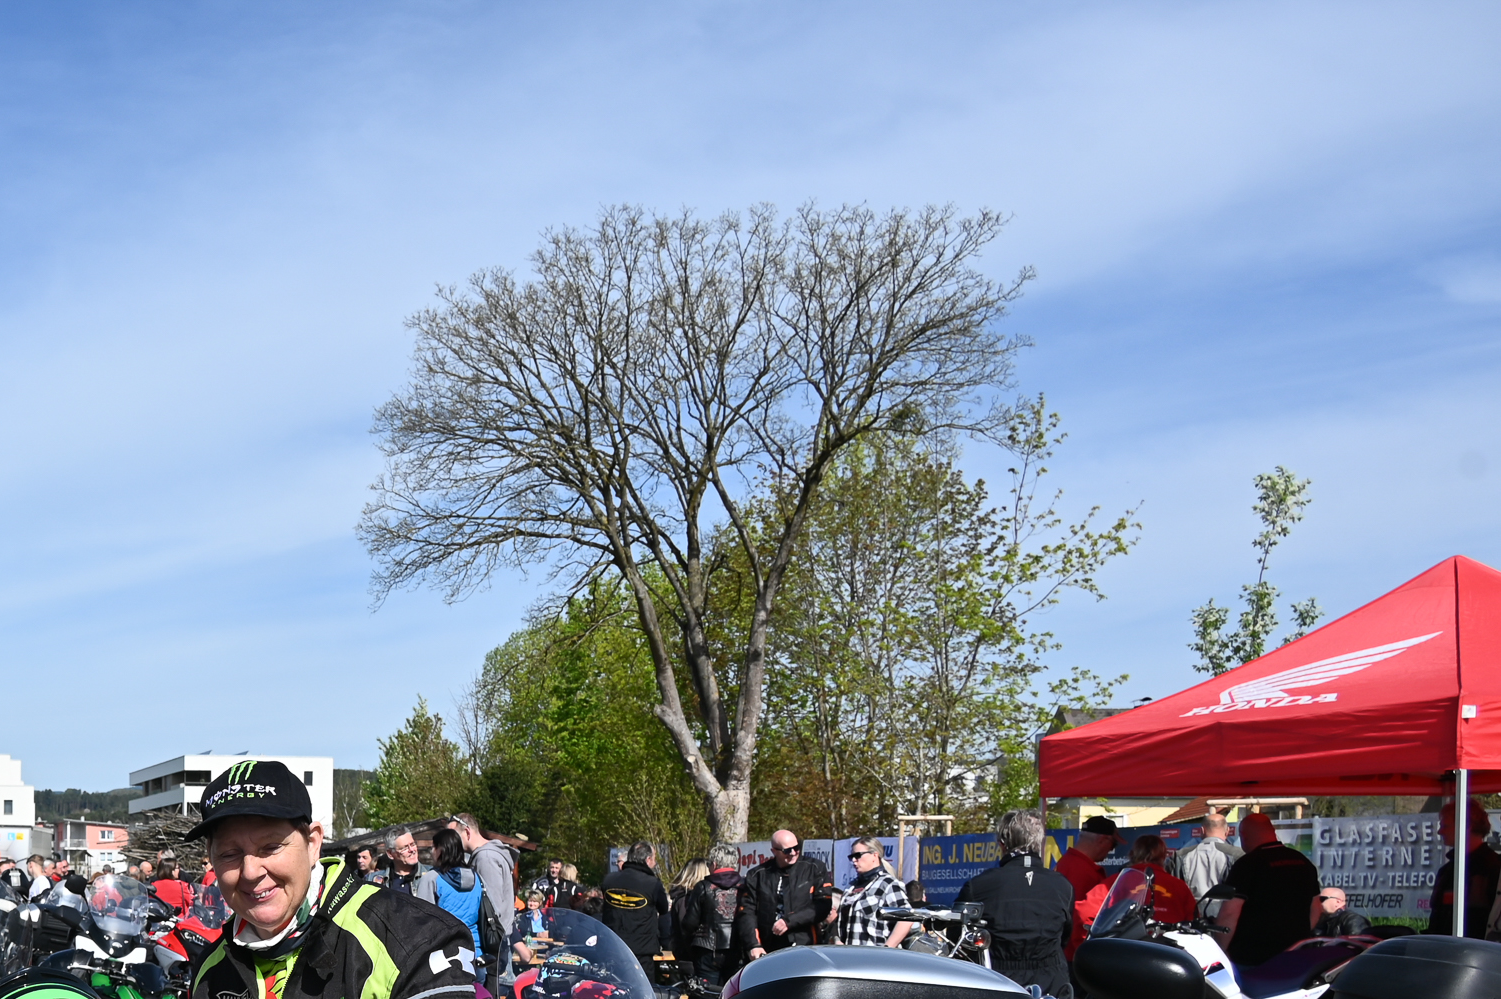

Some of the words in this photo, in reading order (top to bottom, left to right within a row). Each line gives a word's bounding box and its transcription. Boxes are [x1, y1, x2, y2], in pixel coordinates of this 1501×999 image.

[1179, 693, 1338, 717] HONDA
[205, 784, 277, 808] MONSTER
[211, 792, 265, 808] ENERGY
[923, 844, 945, 865] ING.
[948, 843, 960, 864] J.
[1358, 873, 1377, 888] TV
[1386, 872, 1437, 888] TELEFO
[1345, 893, 1405, 909] FFELHOFER
